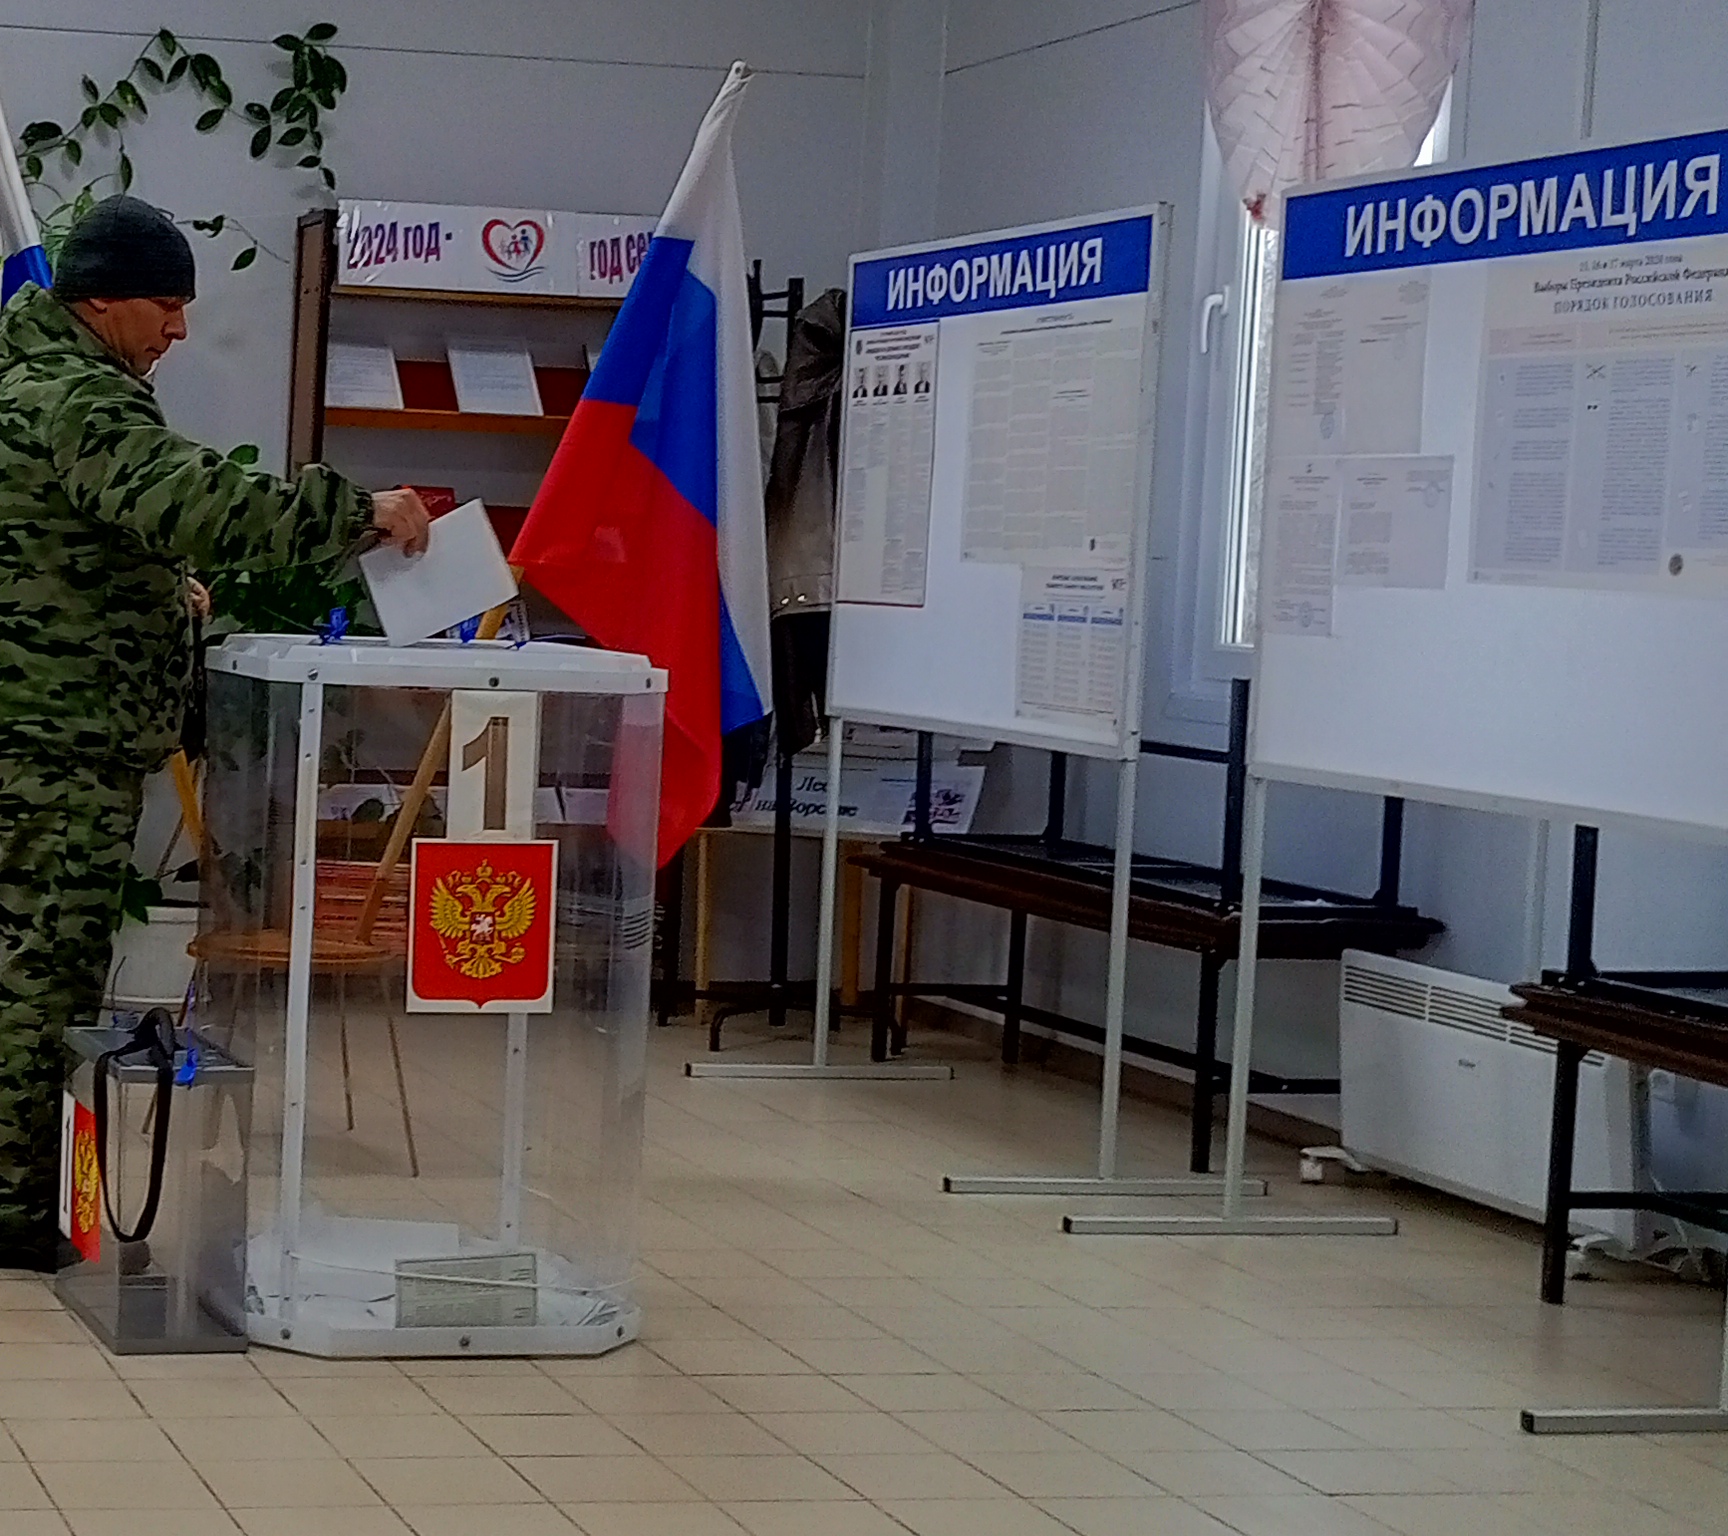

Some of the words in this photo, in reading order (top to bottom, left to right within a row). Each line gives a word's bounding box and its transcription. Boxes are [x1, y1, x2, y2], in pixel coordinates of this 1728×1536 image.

[1344, 154, 1721, 257] ИНФОРМАЦИЯ
[347, 221, 398, 270] 2024
[625, 231, 653, 275] се
[886, 237, 1103, 311] ИНФОРМАЦИЯ
[1613, 288, 1713, 310] ГОЛОСОВАНИЯ
[461, 716, 508, 831] 1
